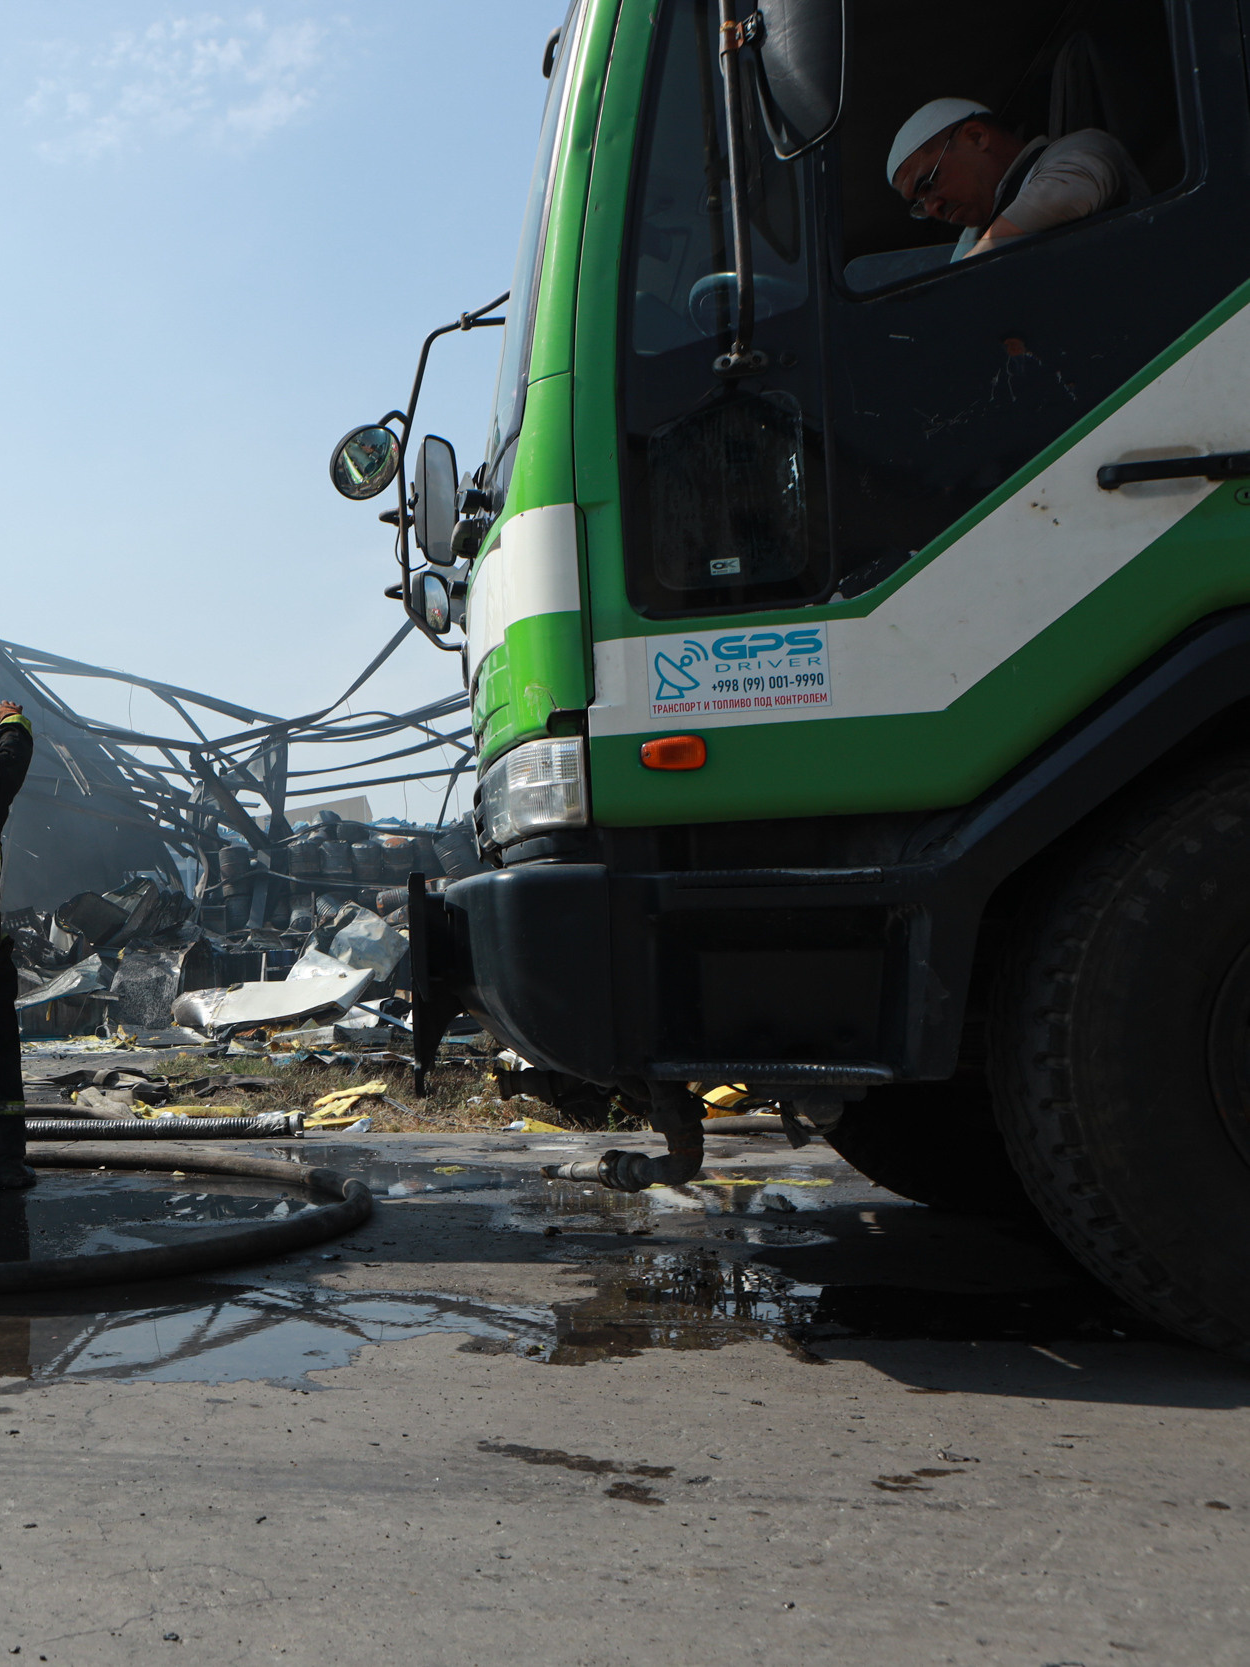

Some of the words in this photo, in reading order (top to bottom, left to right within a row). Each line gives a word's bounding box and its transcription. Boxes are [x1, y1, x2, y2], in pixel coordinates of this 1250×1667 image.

[712, 629, 823, 660] GPS
[715, 657, 822, 673] DRIVER
[711, 680, 739, 693] +998
[743, 676, 765, 693] (99)
[769, 672, 824, 689] 001-9990
[652, 701, 701, 715] ТРАНСПОРТ
[704, 701, 710, 710] И
[712, 698, 751, 710] ТОПЛИВО
[754, 696, 773, 708] ПОД
[775, 692, 828, 706] КОНТРОЛЕМ
